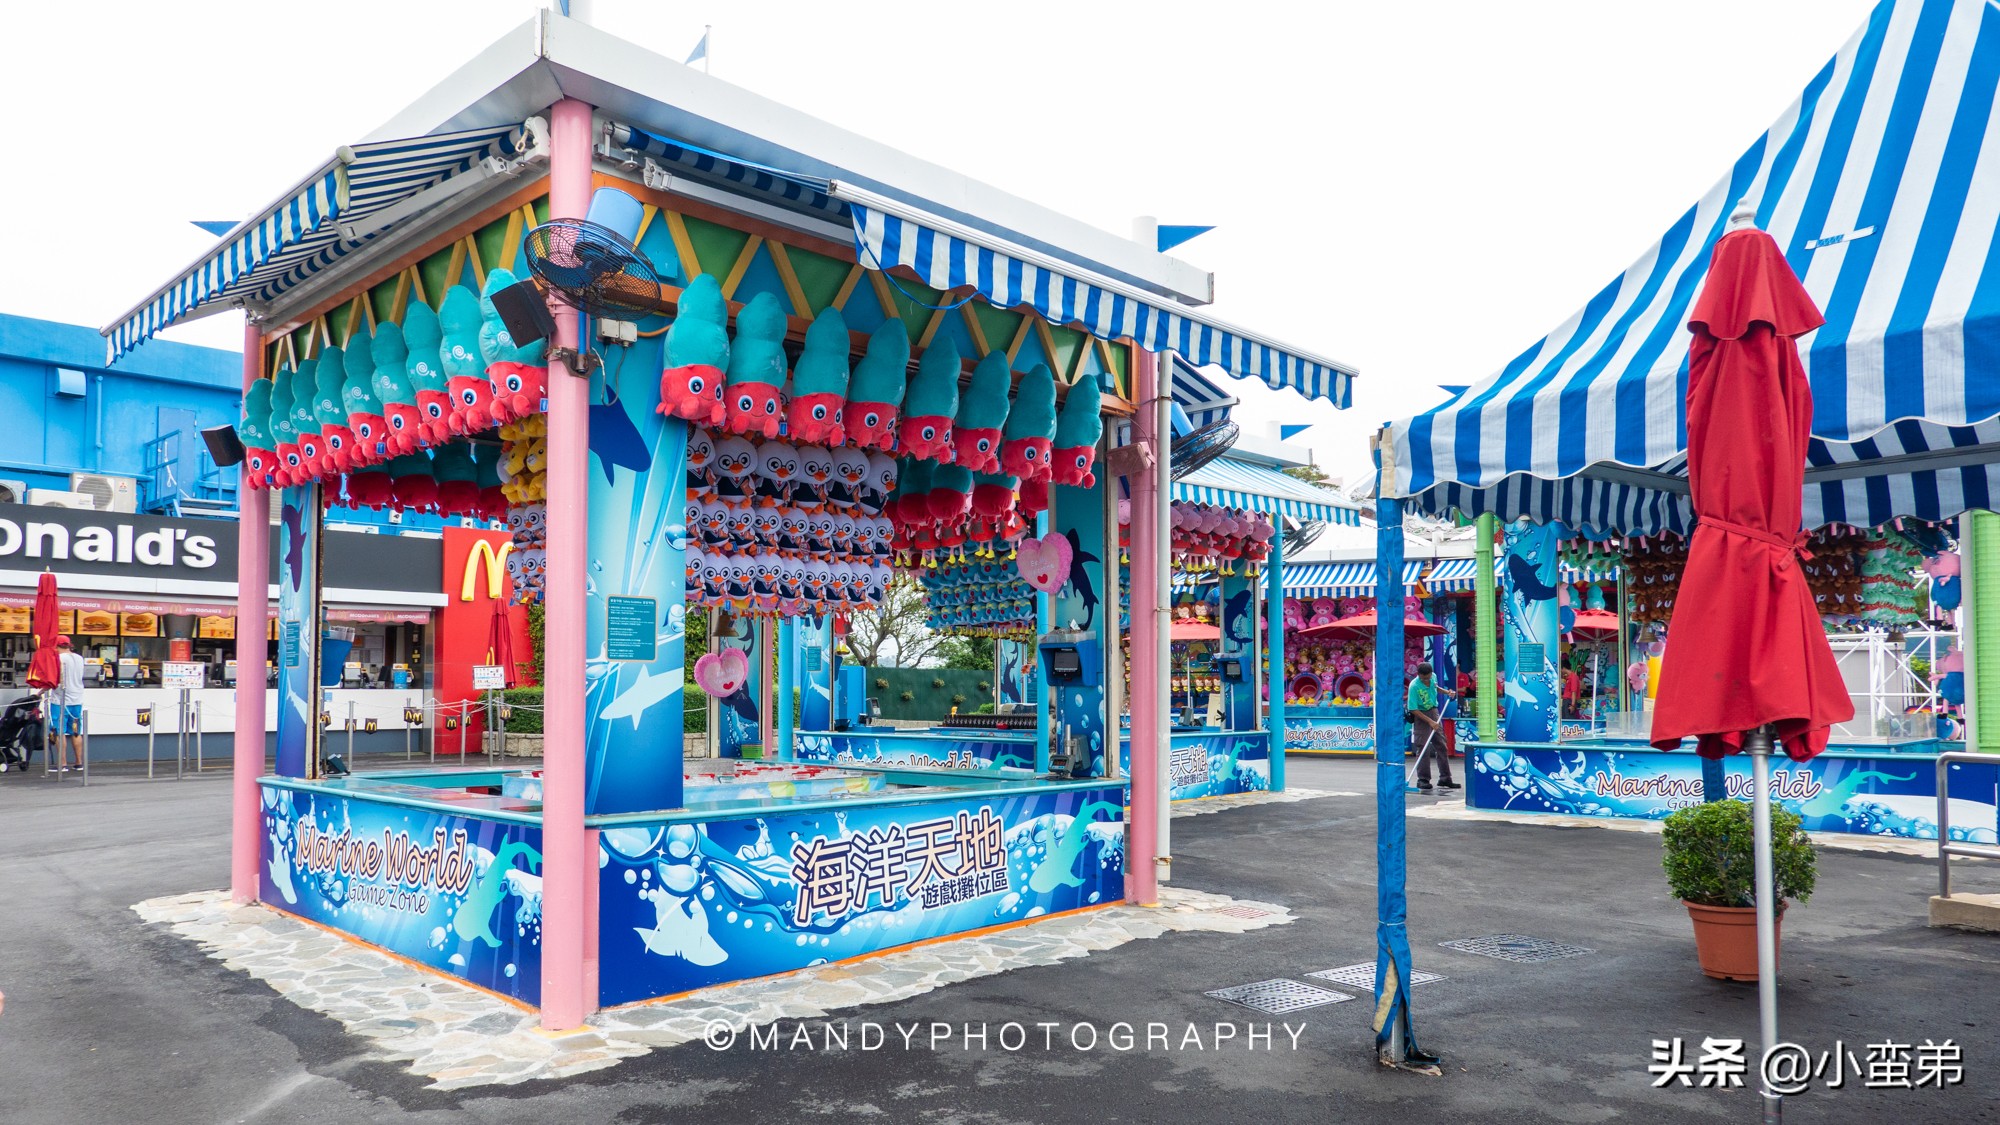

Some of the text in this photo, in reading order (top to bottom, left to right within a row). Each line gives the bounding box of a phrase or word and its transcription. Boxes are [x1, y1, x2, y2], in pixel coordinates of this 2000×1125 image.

[60, 600, 101, 608] McDonald's
[124, 604, 163, 612] McDonald's
[1312, 740, 1367, 748] Game Zone
[1336, 723, 1375, 740] Worl
[1170, 743, 1208, 781] 天地
[1596, 771, 1704, 797] Marine
[296, 820, 474, 896] Marine World
[791, 806, 1007, 925] 海洋天地
[347, 877, 431, 915] Game Zone
[920, 866, 1010, 911] 遊戲攤位區
